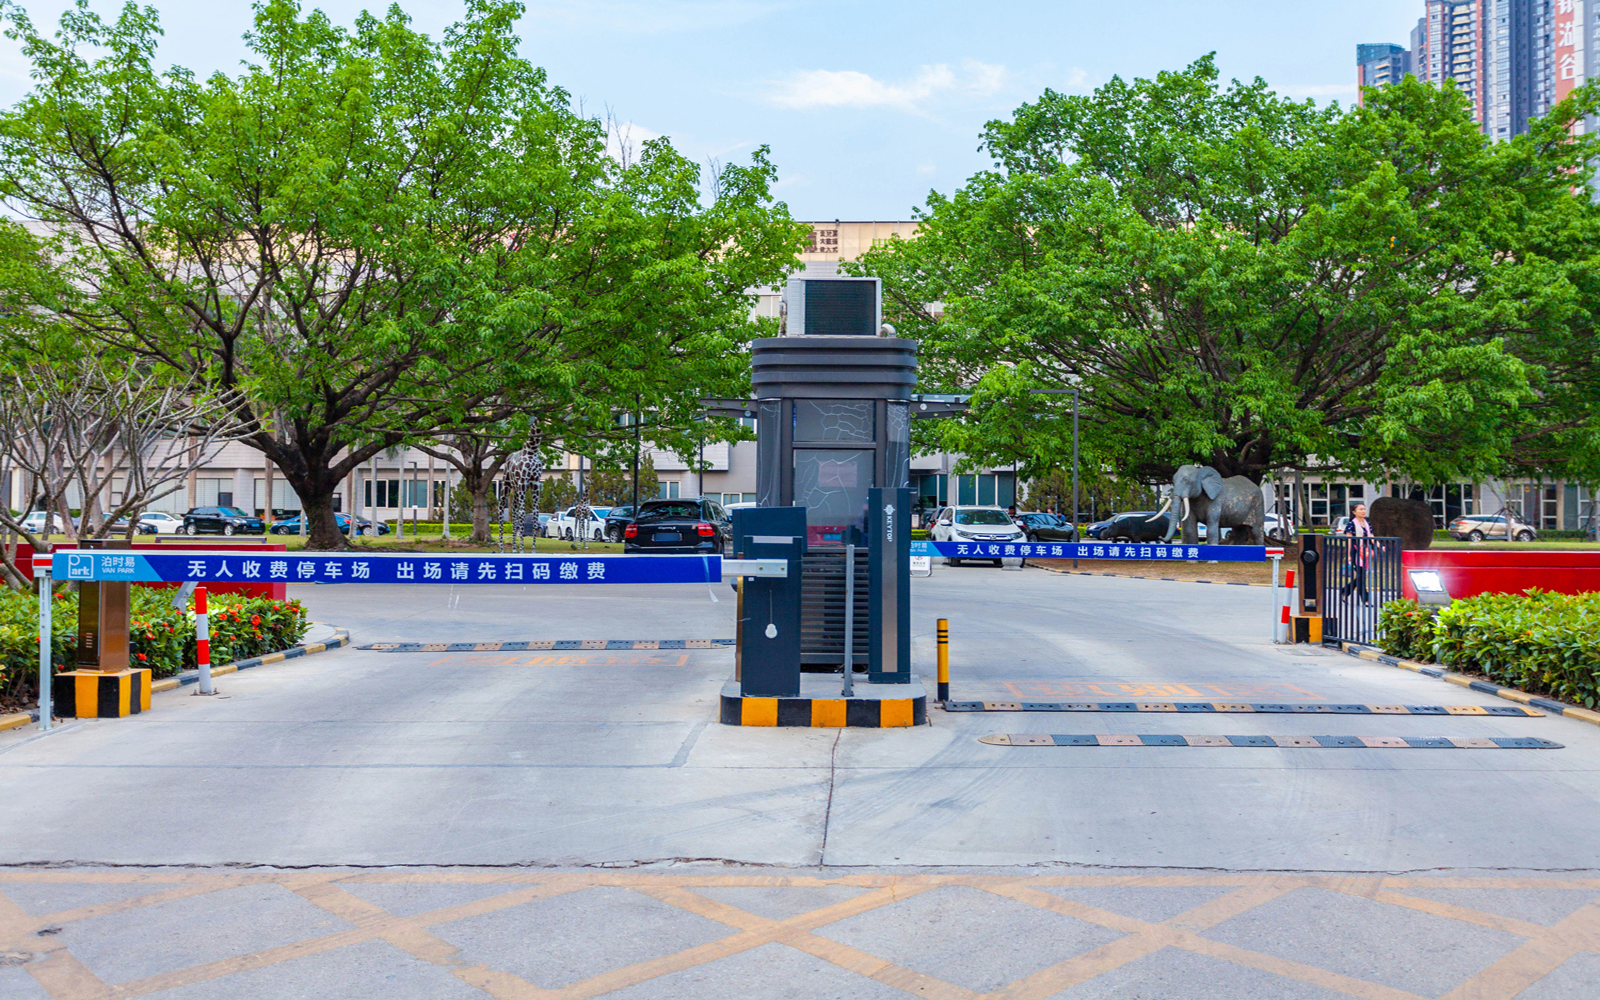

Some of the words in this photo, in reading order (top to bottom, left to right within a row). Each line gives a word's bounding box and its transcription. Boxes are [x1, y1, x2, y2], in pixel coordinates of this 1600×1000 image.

[957, 544, 1063, 556] 无人收费停车场
[1077, 545, 1199, 558] 出场请先扫码缴费
[101, 556, 135, 567] 泊时易
[187, 560, 370, 579] 无人收费停车场
[396, 561, 606, 580] 出场请先扫码缴费
